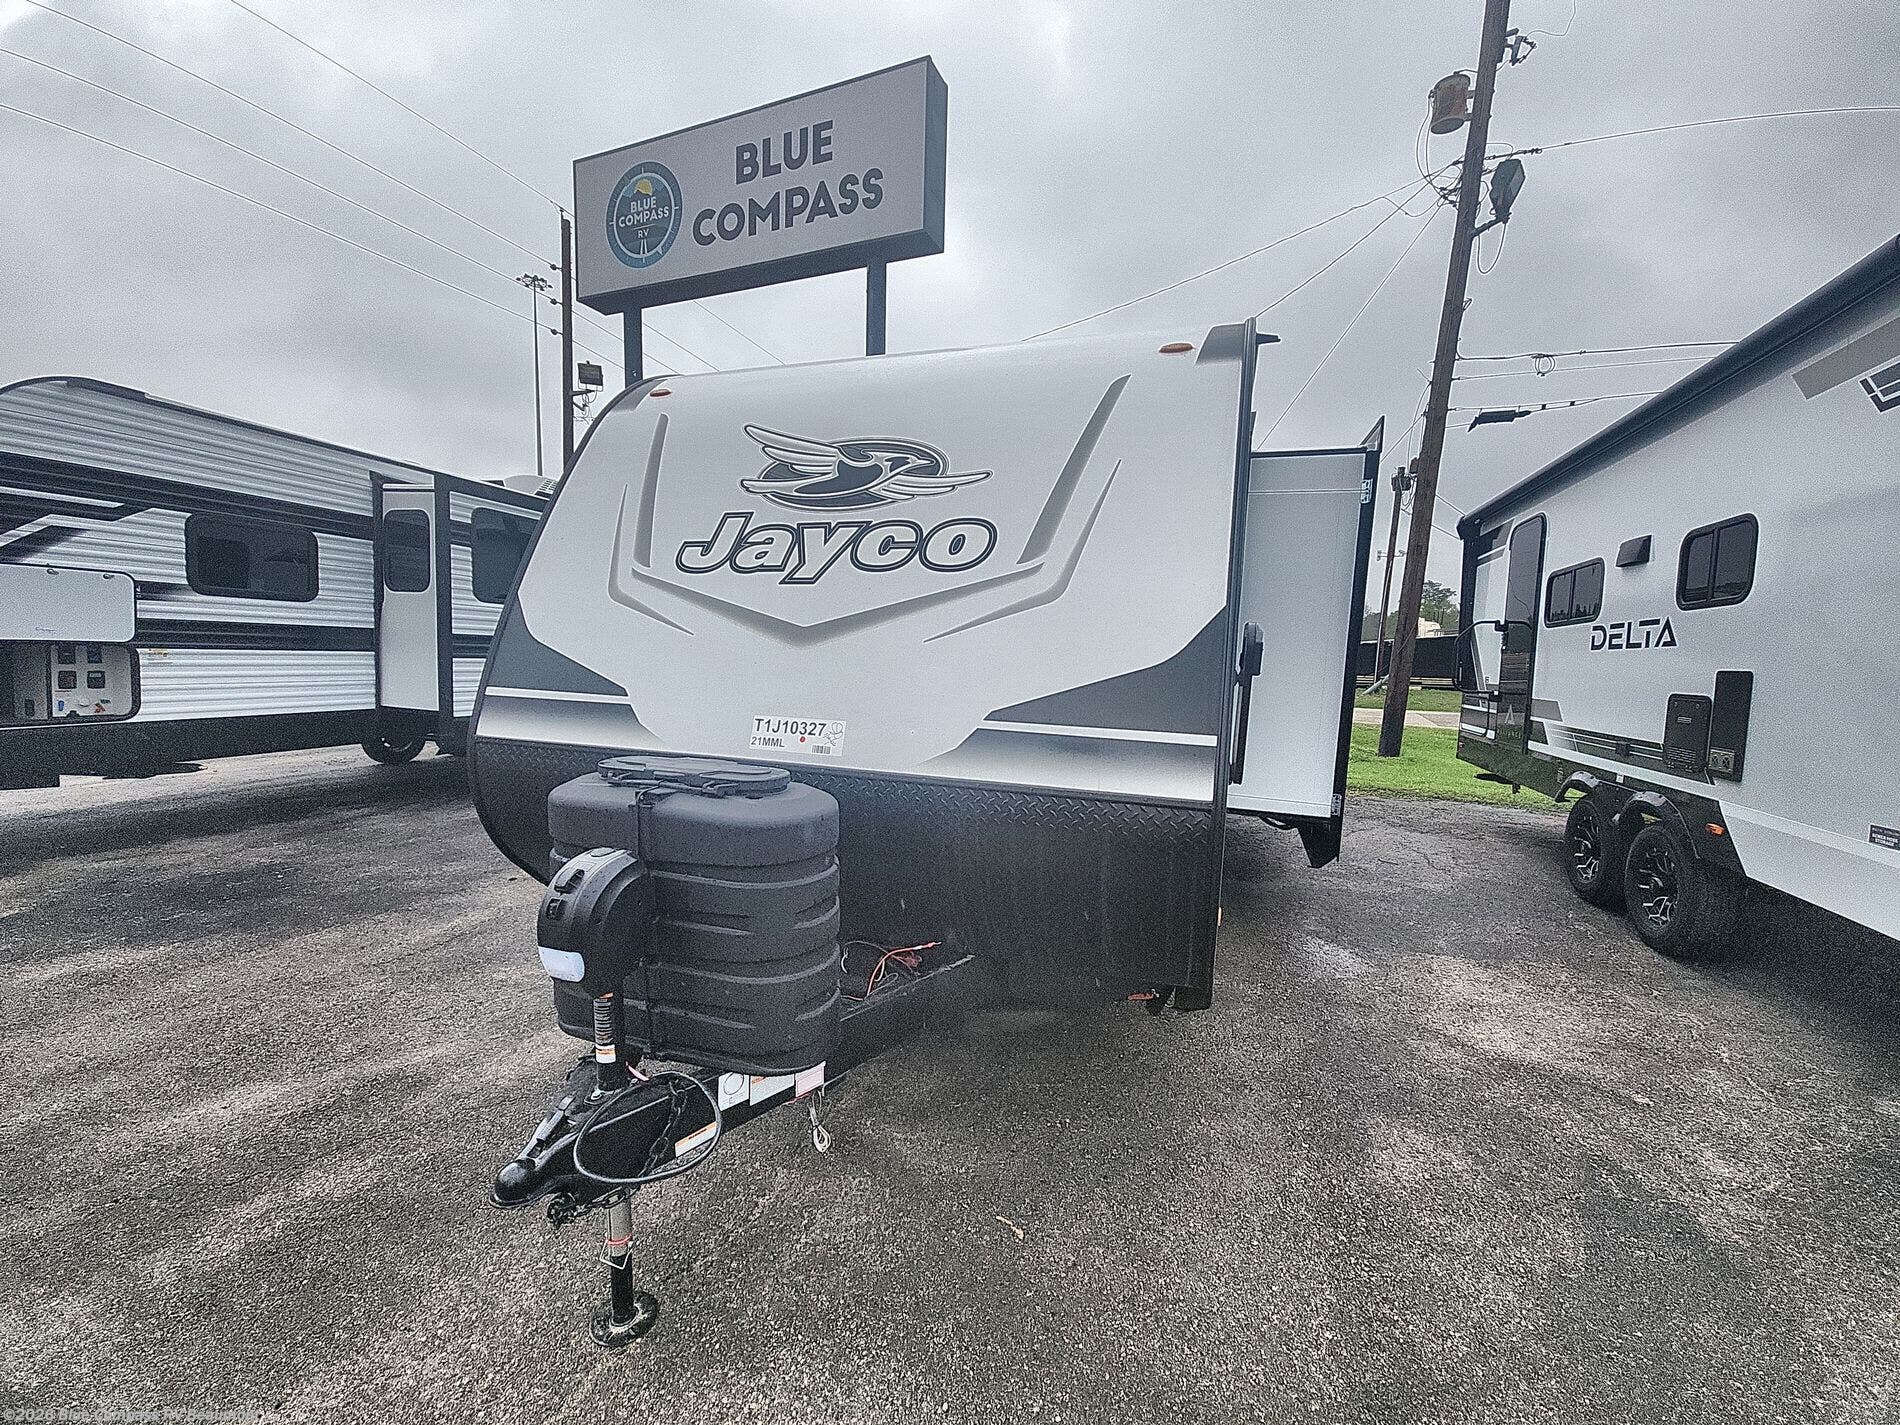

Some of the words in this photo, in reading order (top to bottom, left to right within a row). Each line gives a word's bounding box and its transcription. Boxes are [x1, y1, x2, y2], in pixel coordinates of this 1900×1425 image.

[735, 120, 833, 184] BLUE
[631, 196, 656, 213] BLUE
[693, 168, 884, 246] COMPASS
[618, 206, 669, 228] COMPASS
[638, 229, 649, 238] RV
[675, 511, 998, 585] Jayco
[1590, 616, 1677, 650] DELTA
[755, 718, 827, 736] T1J10327
[751, 736, 785, 748] 21MML
